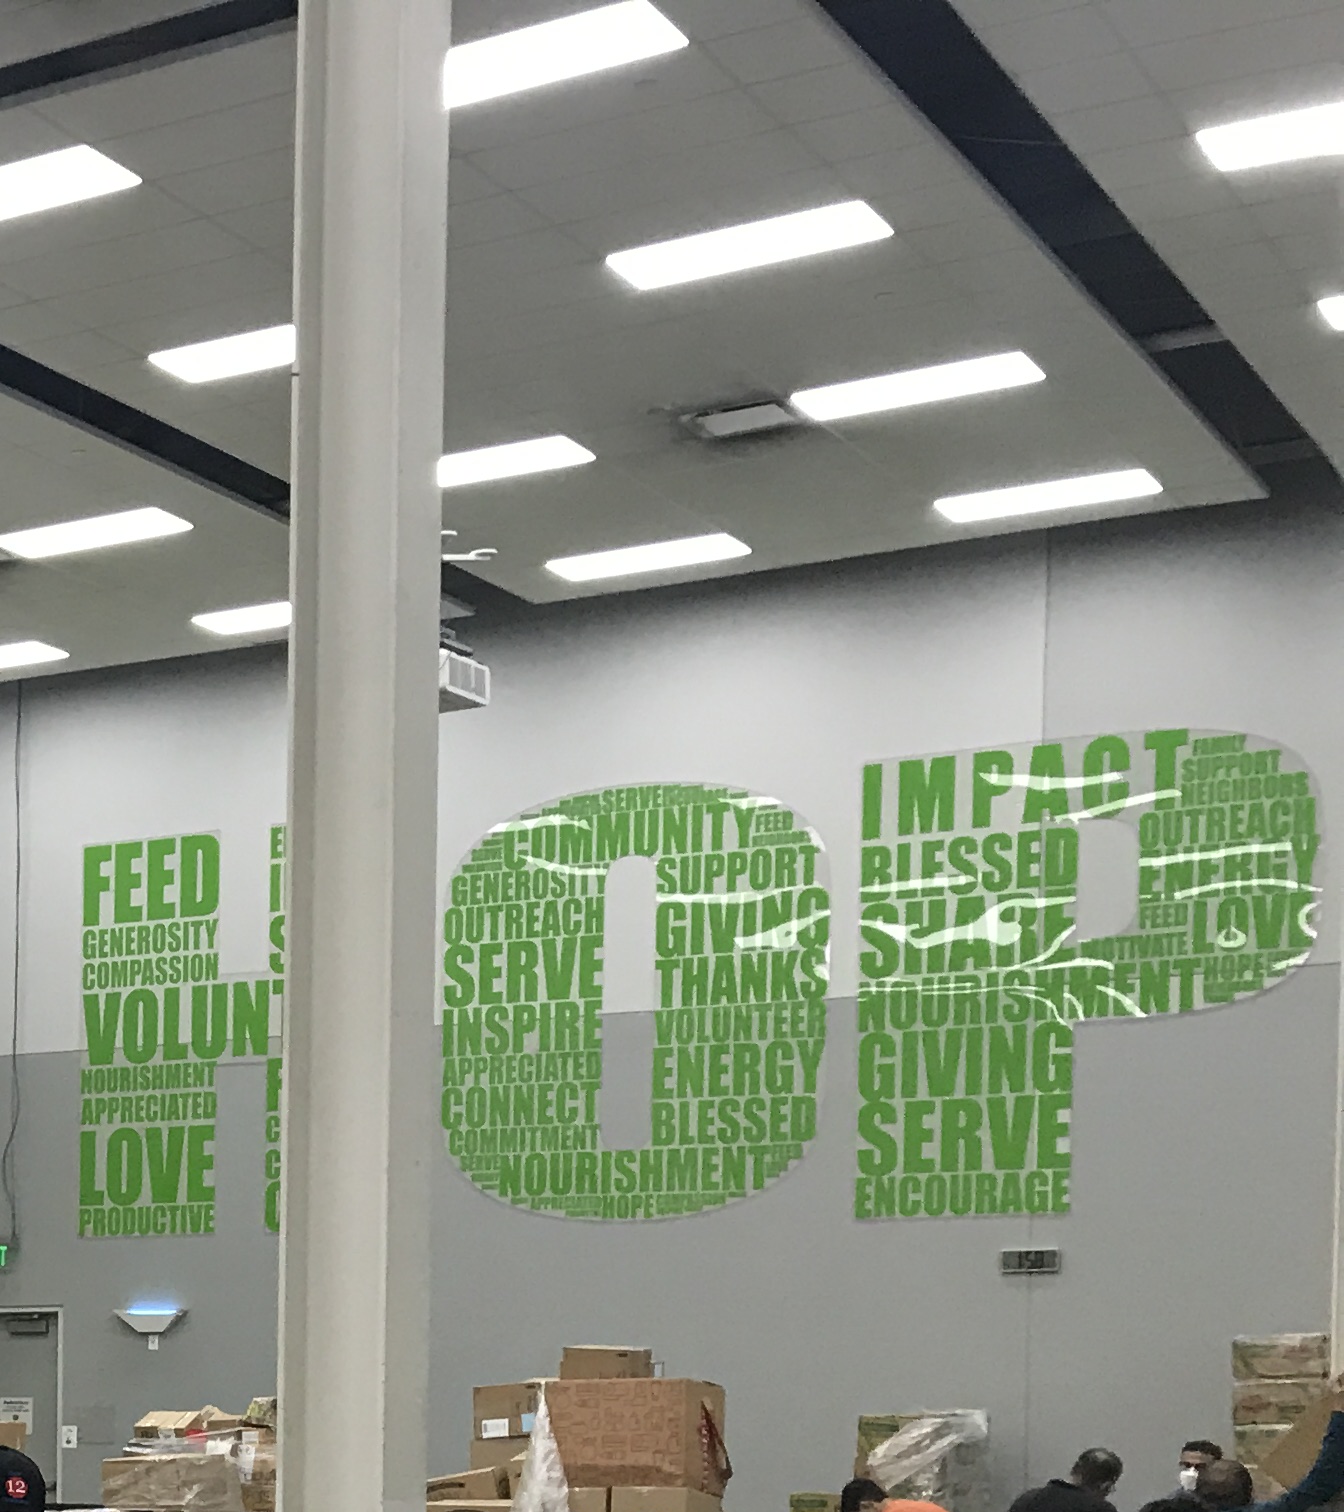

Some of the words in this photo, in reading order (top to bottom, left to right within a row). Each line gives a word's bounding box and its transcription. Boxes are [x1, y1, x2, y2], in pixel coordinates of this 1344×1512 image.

[861, 728, 1189, 841] IMPACT
[1180, 771, 1309, 807] NEIGHBORS
[1181, 749, 1283, 782] SUPPORT
[502, 801, 755, 871] COMMUNITY
[1139, 797, 1316, 850] OUTREACH
[83, 834, 220, 926] FEED
[452, 865, 606, 907] GENEROSITY
[656, 846, 822, 896] SUPPORT
[83, 919, 219, 960] GENEROSITY
[444, 896, 604, 945] OUTREACH
[655, 886, 831, 959] GIVING
[83, 953, 219, 991] COMPASSION
[443, 935, 605, 1008] SERVE
[655, 945, 831, 1009] THANKS
[442, 1000, 603, 1057] INSPIRE
[654, 1000, 828, 1046] VOLUNTEER
[81, 1060, 218, 1094] NOURISHMENT
[442, 1051, 601, 1087] APPRECIATED
[652, 1039, 827, 1099] ENERGY
[858, 1020, 1073, 1104] GIVING
[81, 1092, 218, 1125] APPRECIATED
[441, 1082, 601, 1130] CONNECT
[651, 1096, 817, 1147] BLESSED
[449, 1123, 600, 1156] COMMITMENT
[857, 1093, 1072, 1177] SERVE
[79, 1125, 216, 1206] LOVE
[498, 1146, 770, 1198] NOURISHMENT
[855, 1170, 1071, 1219] ENCOURAGE
[79, 1203, 216, 1236] PRODUCTIVE
[7, 1480, 27, 1493] 12
